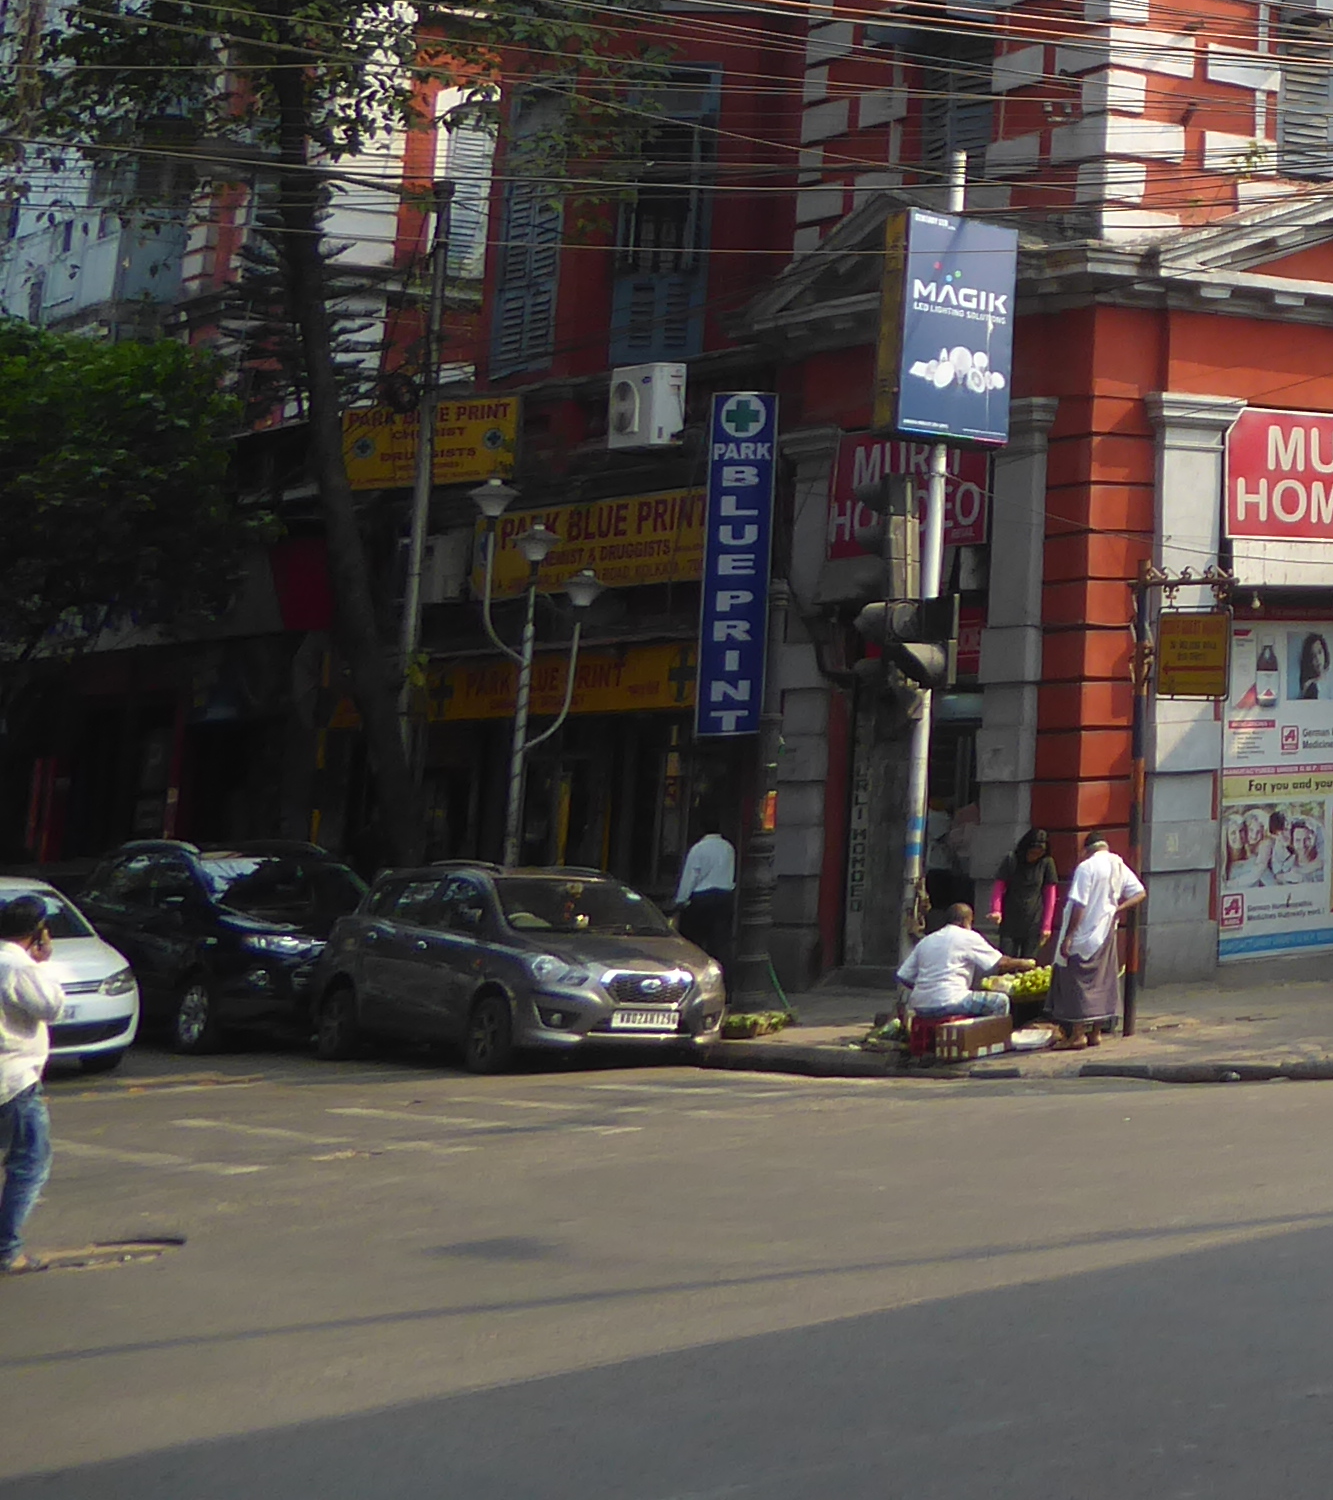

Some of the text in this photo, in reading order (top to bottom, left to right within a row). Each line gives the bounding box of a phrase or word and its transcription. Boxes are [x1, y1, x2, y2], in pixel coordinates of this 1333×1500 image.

[913, 279, 1008, 314] MAGIK
[913, 301, 929, 312] LED
[930, 304, 965, 318] LIGHTING
[455, 403, 511, 421] PRINT
[713, 442, 772, 461] PARK
[566, 503, 629, 544] BLUE
[710, 465, 760, 732] BLUE PRINT
[1248, 779, 1267, 792] For
[1271, 782, 1291, 793] you
[1292, 778, 1312, 789] and
